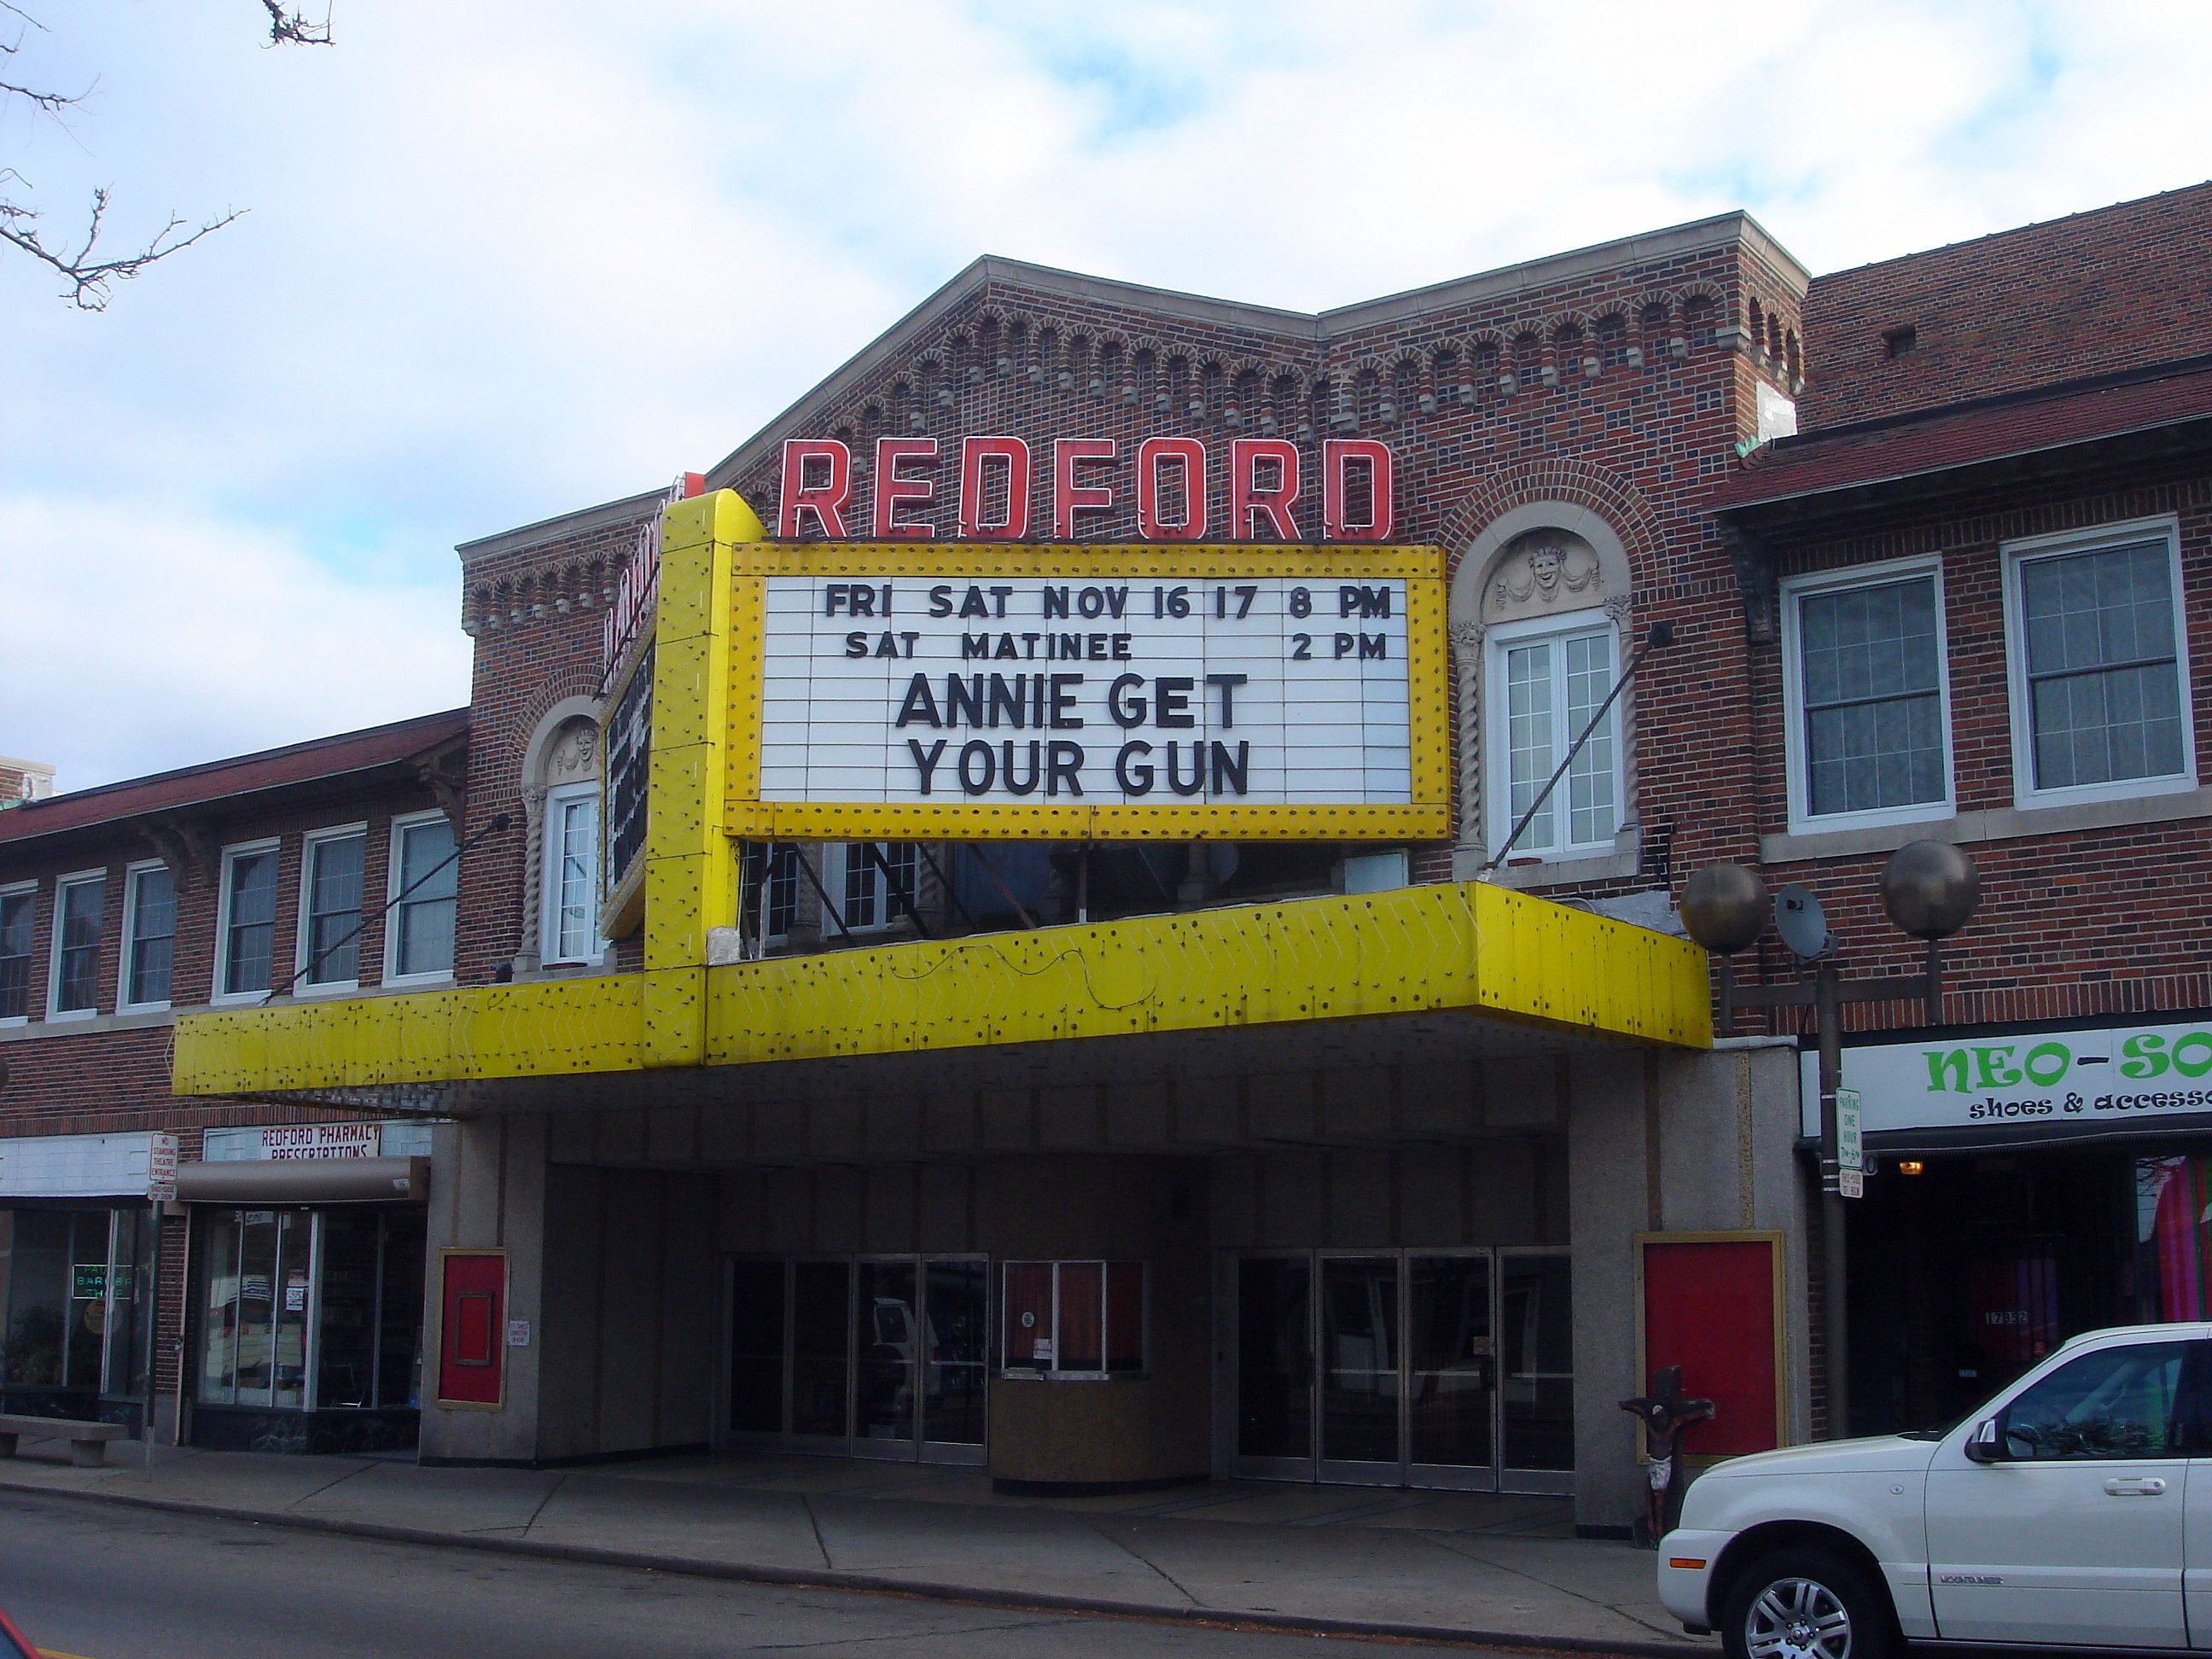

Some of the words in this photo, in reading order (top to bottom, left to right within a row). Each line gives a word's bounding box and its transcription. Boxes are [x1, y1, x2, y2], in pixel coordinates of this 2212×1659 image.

[777, 436, 1394, 539] REDFORD
[826, 585, 892, 617] FRI
[929, 585, 1013, 618] SAT
[1044, 586, 1129, 619] NOV
[1155, 586, 1190, 619] 16
[1216, 586, 1258, 619] 17
[1289, 586, 1313, 619] 8
[1340, 586, 1390, 619] PM
[846, 632, 919, 658] SAT
[962, 632, 1132, 660] MATINEE
[1293, 633, 1312, 660] 2
[1335, 632, 1386, 660] PM
[895, 672, 1084, 729] ANNIE
[1109, 672, 1248, 729] GET
[907, 739, 1085, 796] YOUR
[1115, 740, 1249, 796] GUN
[1970, 1098, 2053, 1119] shoes
[2064, 1092, 2084, 1114] &
[1844, 1114, 1855, 1127] ONE
[262, 1127, 313, 1146] REDFORD
[320, 1124, 380, 1144] PHARMACY
[154, 1147, 177, 1155] STANDING
[77, 1277, 132, 1286] BARER
[84, 1289, 124, 1297] SHP
